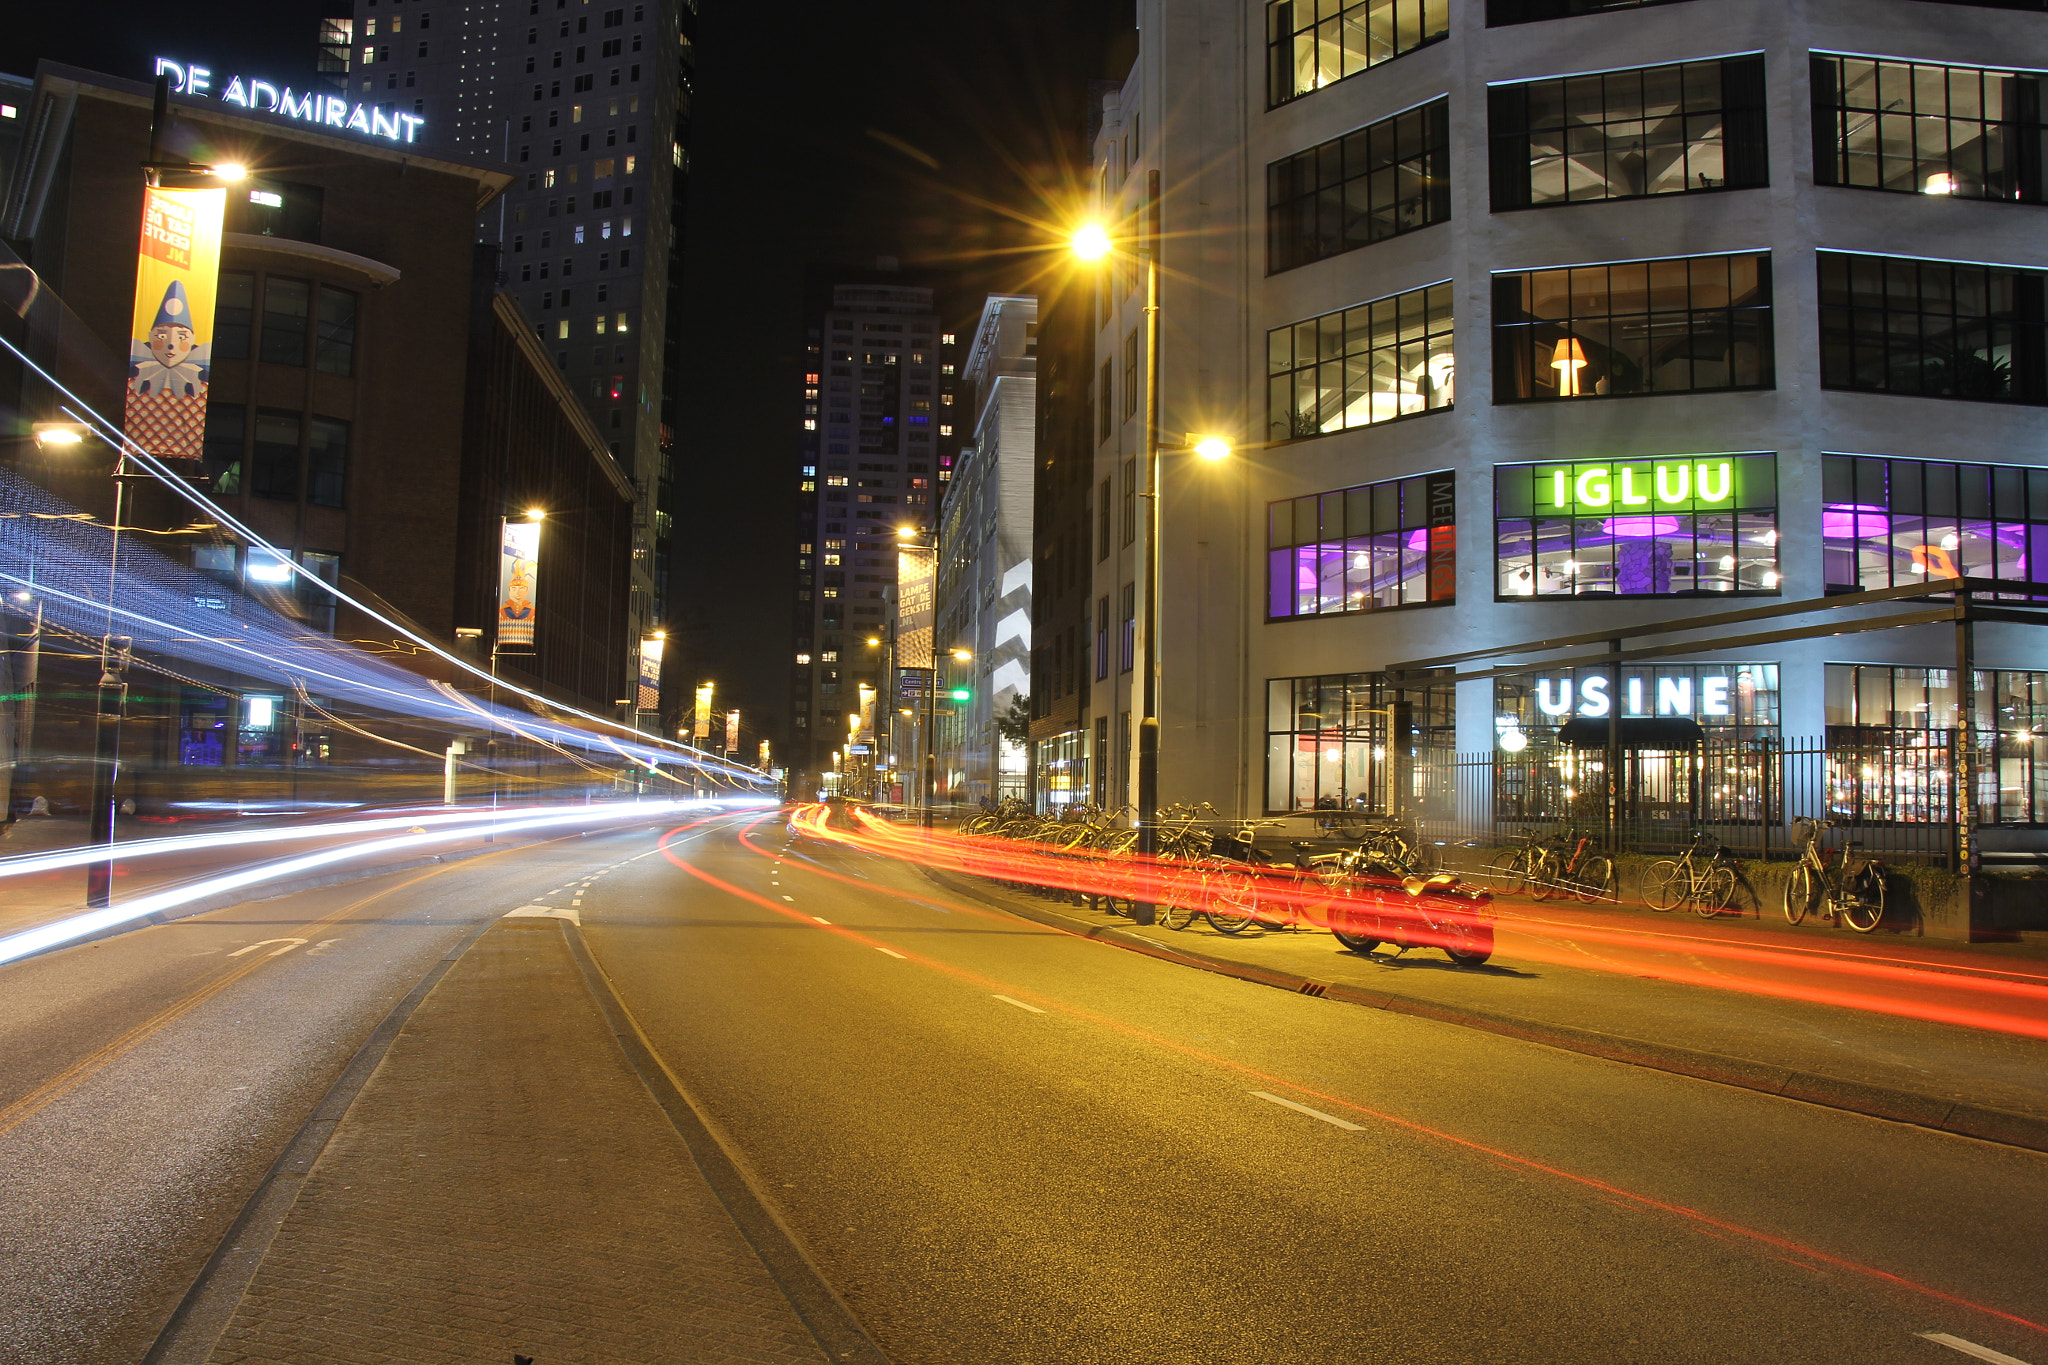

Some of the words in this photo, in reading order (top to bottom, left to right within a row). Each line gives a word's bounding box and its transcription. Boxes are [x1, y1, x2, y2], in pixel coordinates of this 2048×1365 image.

[156, 57, 210, 97] DE
[222, 75, 425, 143] ADMIRANT
[1554, 463, 1730, 508] IGLUU
[1432, 482, 1453, 591] MEETINGS
[900, 583, 930, 599] LAMPE
[900, 596, 916, 608] GAT
[920, 591, 931, 602] DE
[900, 601, 931, 618] GEKSTE
[1538, 676, 1729, 717] USINE
